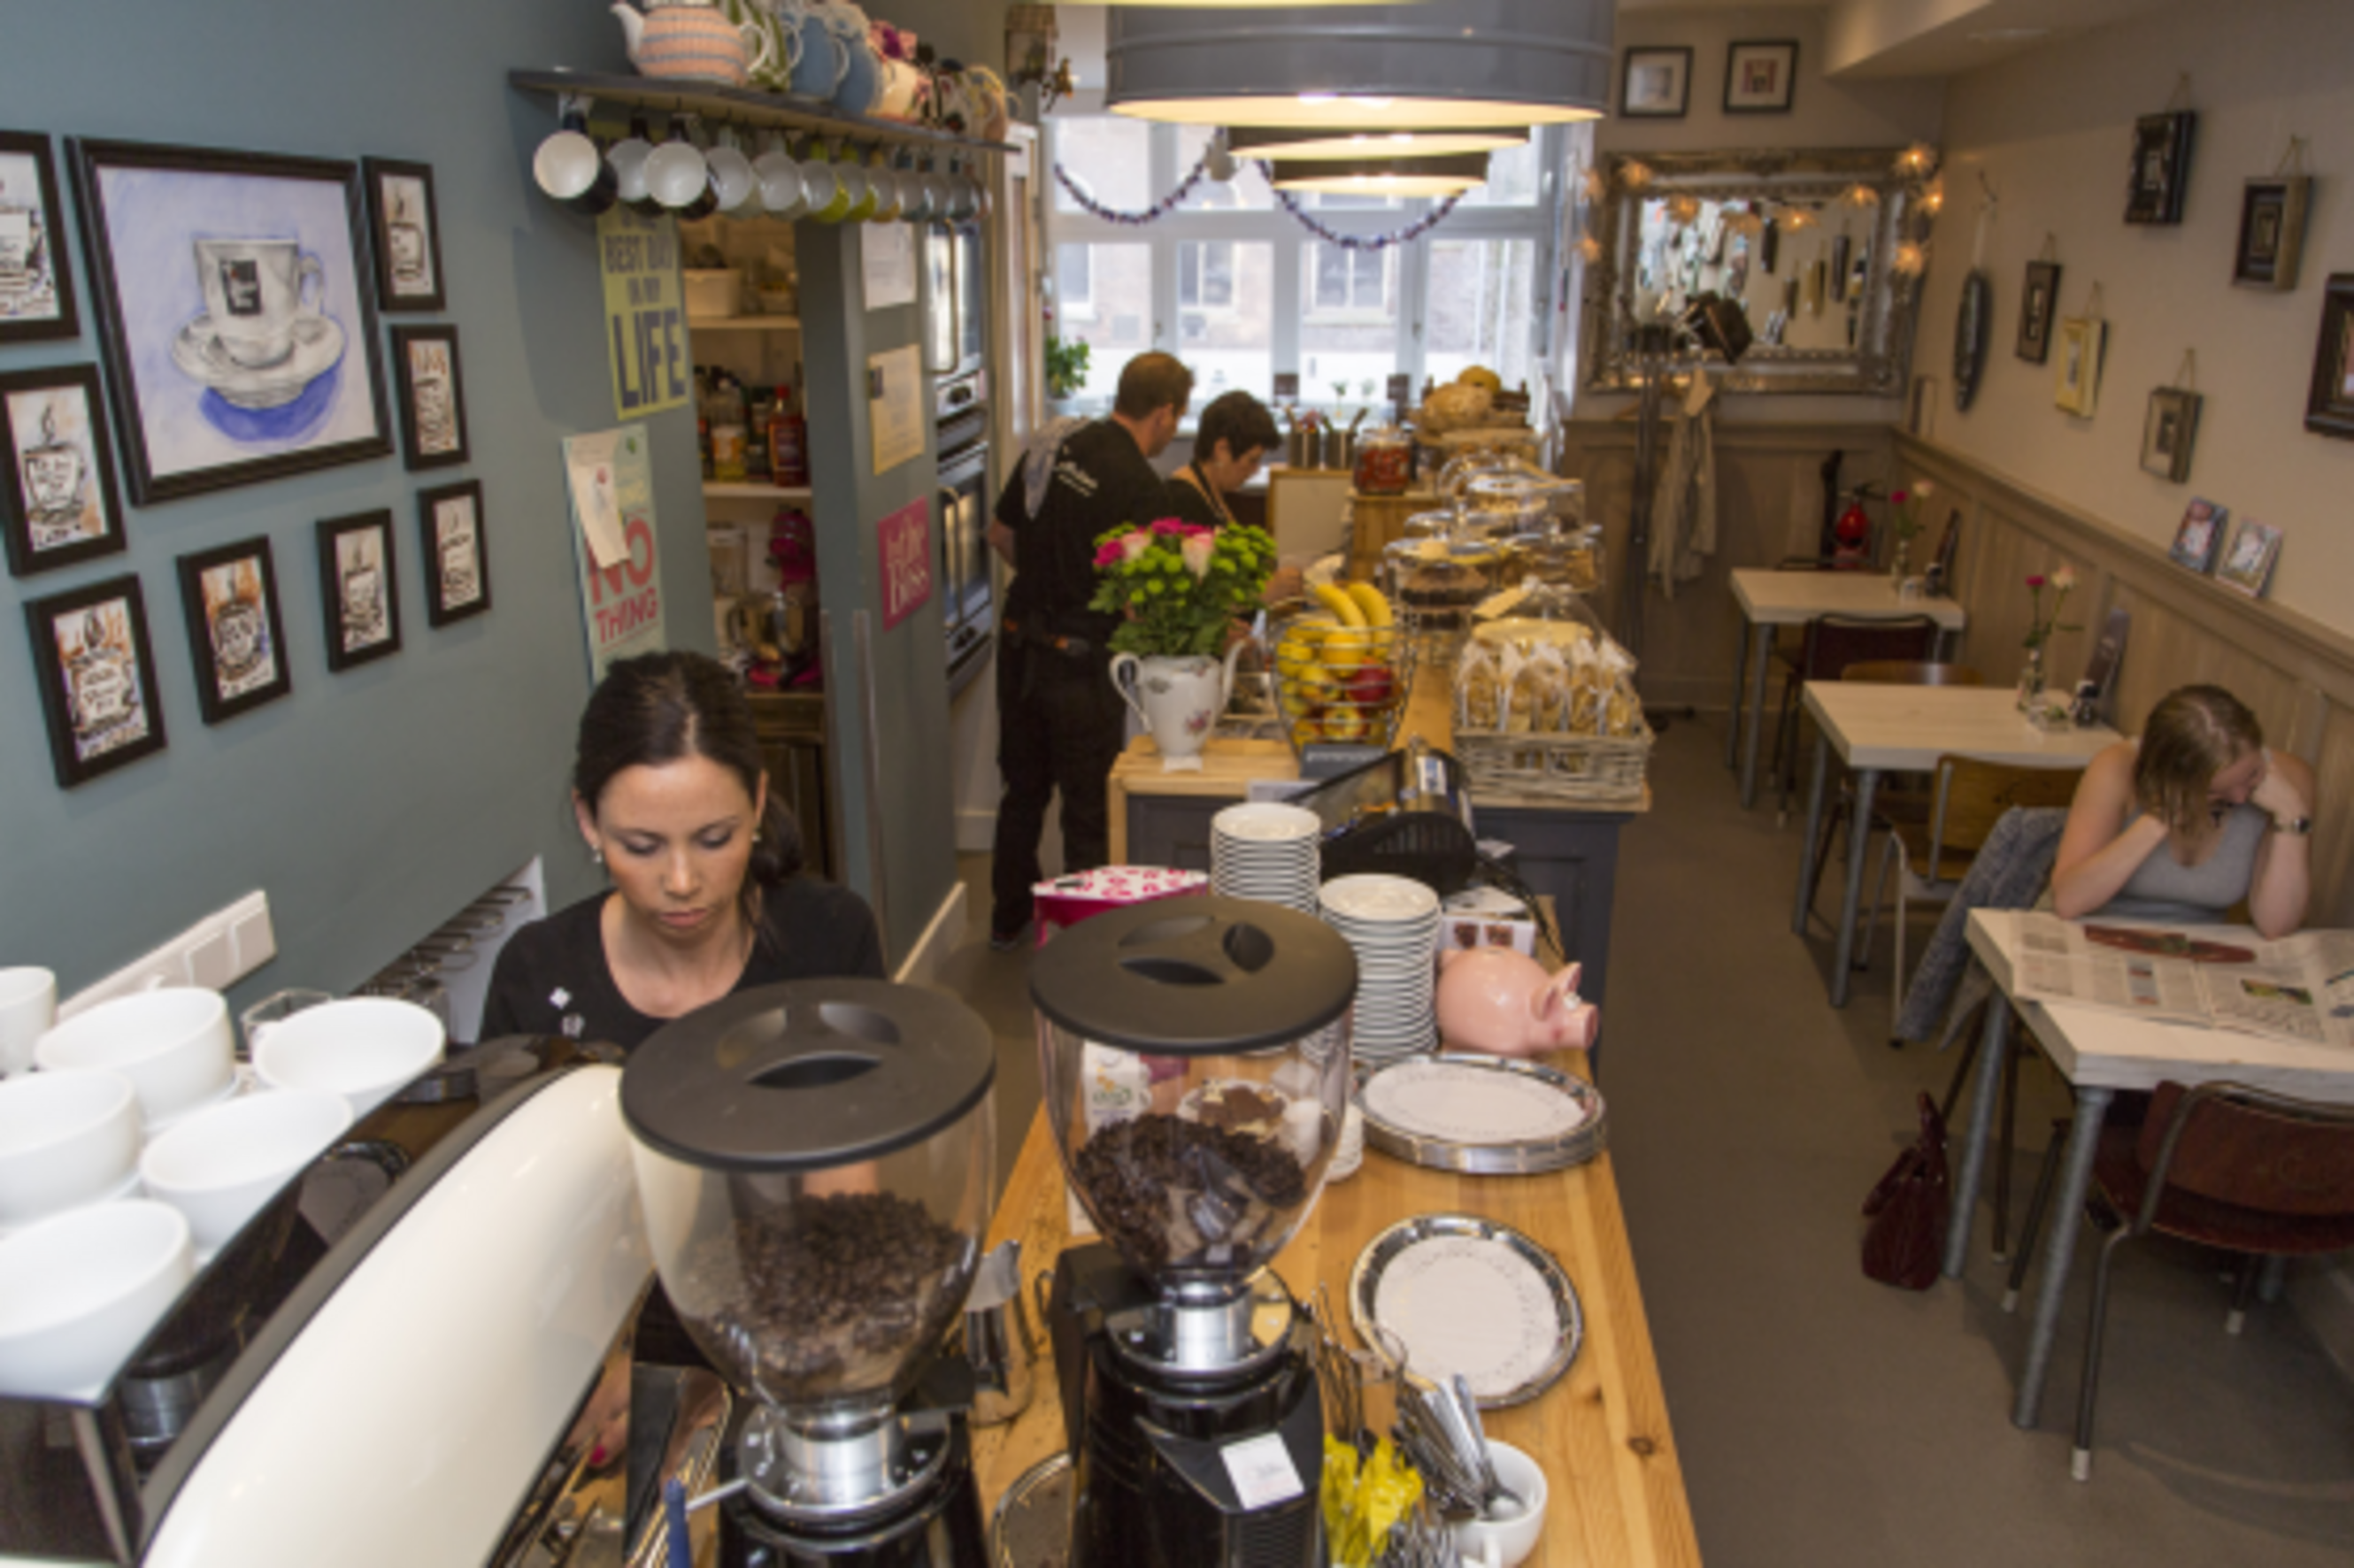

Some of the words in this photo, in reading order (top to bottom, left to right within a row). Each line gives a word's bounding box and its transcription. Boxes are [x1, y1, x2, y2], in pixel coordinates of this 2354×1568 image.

[604, 234, 643, 273] BEST
[613, 308, 686, 408] LIFE
[595, 587, 658, 644] THING
